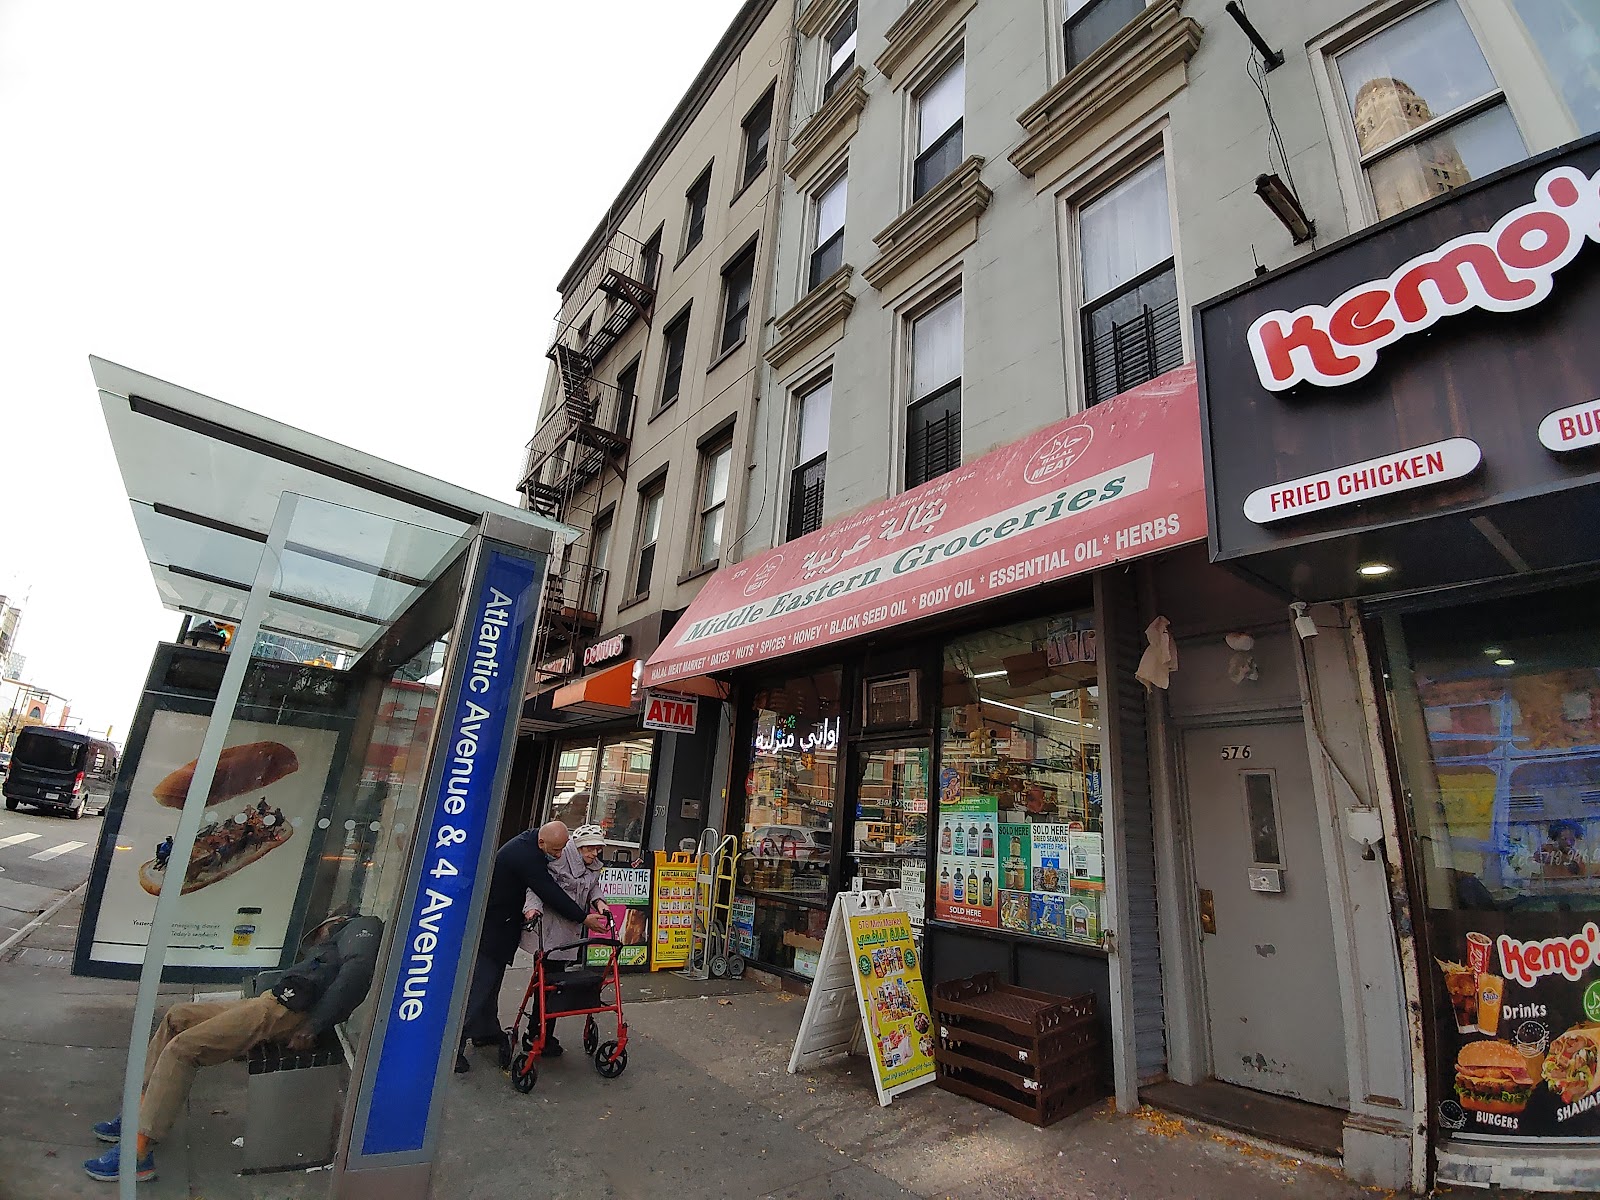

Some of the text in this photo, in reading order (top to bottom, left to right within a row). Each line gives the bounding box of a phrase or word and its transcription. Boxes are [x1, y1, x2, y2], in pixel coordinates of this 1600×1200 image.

[1260, 177, 1600, 381] Kemo'
[1031, 454, 1076, 480] MEAT
[1270, 452, 1445, 512] FRIED CHICKEN
[801, 498, 948, 580] بقالة عربية
[1115, 513, 1181, 551] HERBS
[683, 476, 1127, 643] Middle Eastern Groceries
[989, 537, 1103, 590] ESSENTIAL OIL
[746, 578, 769, 593] MEAT
[919, 578, 976, 611] BODY OIL
[829, 600, 908, 636] BLACK SEED OIL
[760, 636, 787, 653] SPICES
[793, 626, 823, 646] HONEY
[584, 634, 625, 667] DONUTS
[710, 650, 731, 667] DATES
[735, 643, 754, 660] NUTS
[651, 656, 707, 681] HALAL MEAT MARKET
[647, 700, 694, 726] ATM
[1221, 745, 1252, 760] 576
[399, 585, 514, 1022] Atlantic Avenue & 4 Avenue
[999, 825, 1029, 836] SOLD HERE
[1032, 824, 1068, 836] SOLD HERE
[611, 869, 633, 882] HAVE
[634, 870, 648, 883] THE
[634, 884, 648, 896] TEA
[949, 905, 982, 917] SOLD HERE
[594, 948, 640, 957] SOL HERE
[1502, 928, 1600, 982] Kemo'
[1503, 1003, 1547, 1020] Drinks
[1476, 1110, 1519, 1130] BURGERS
